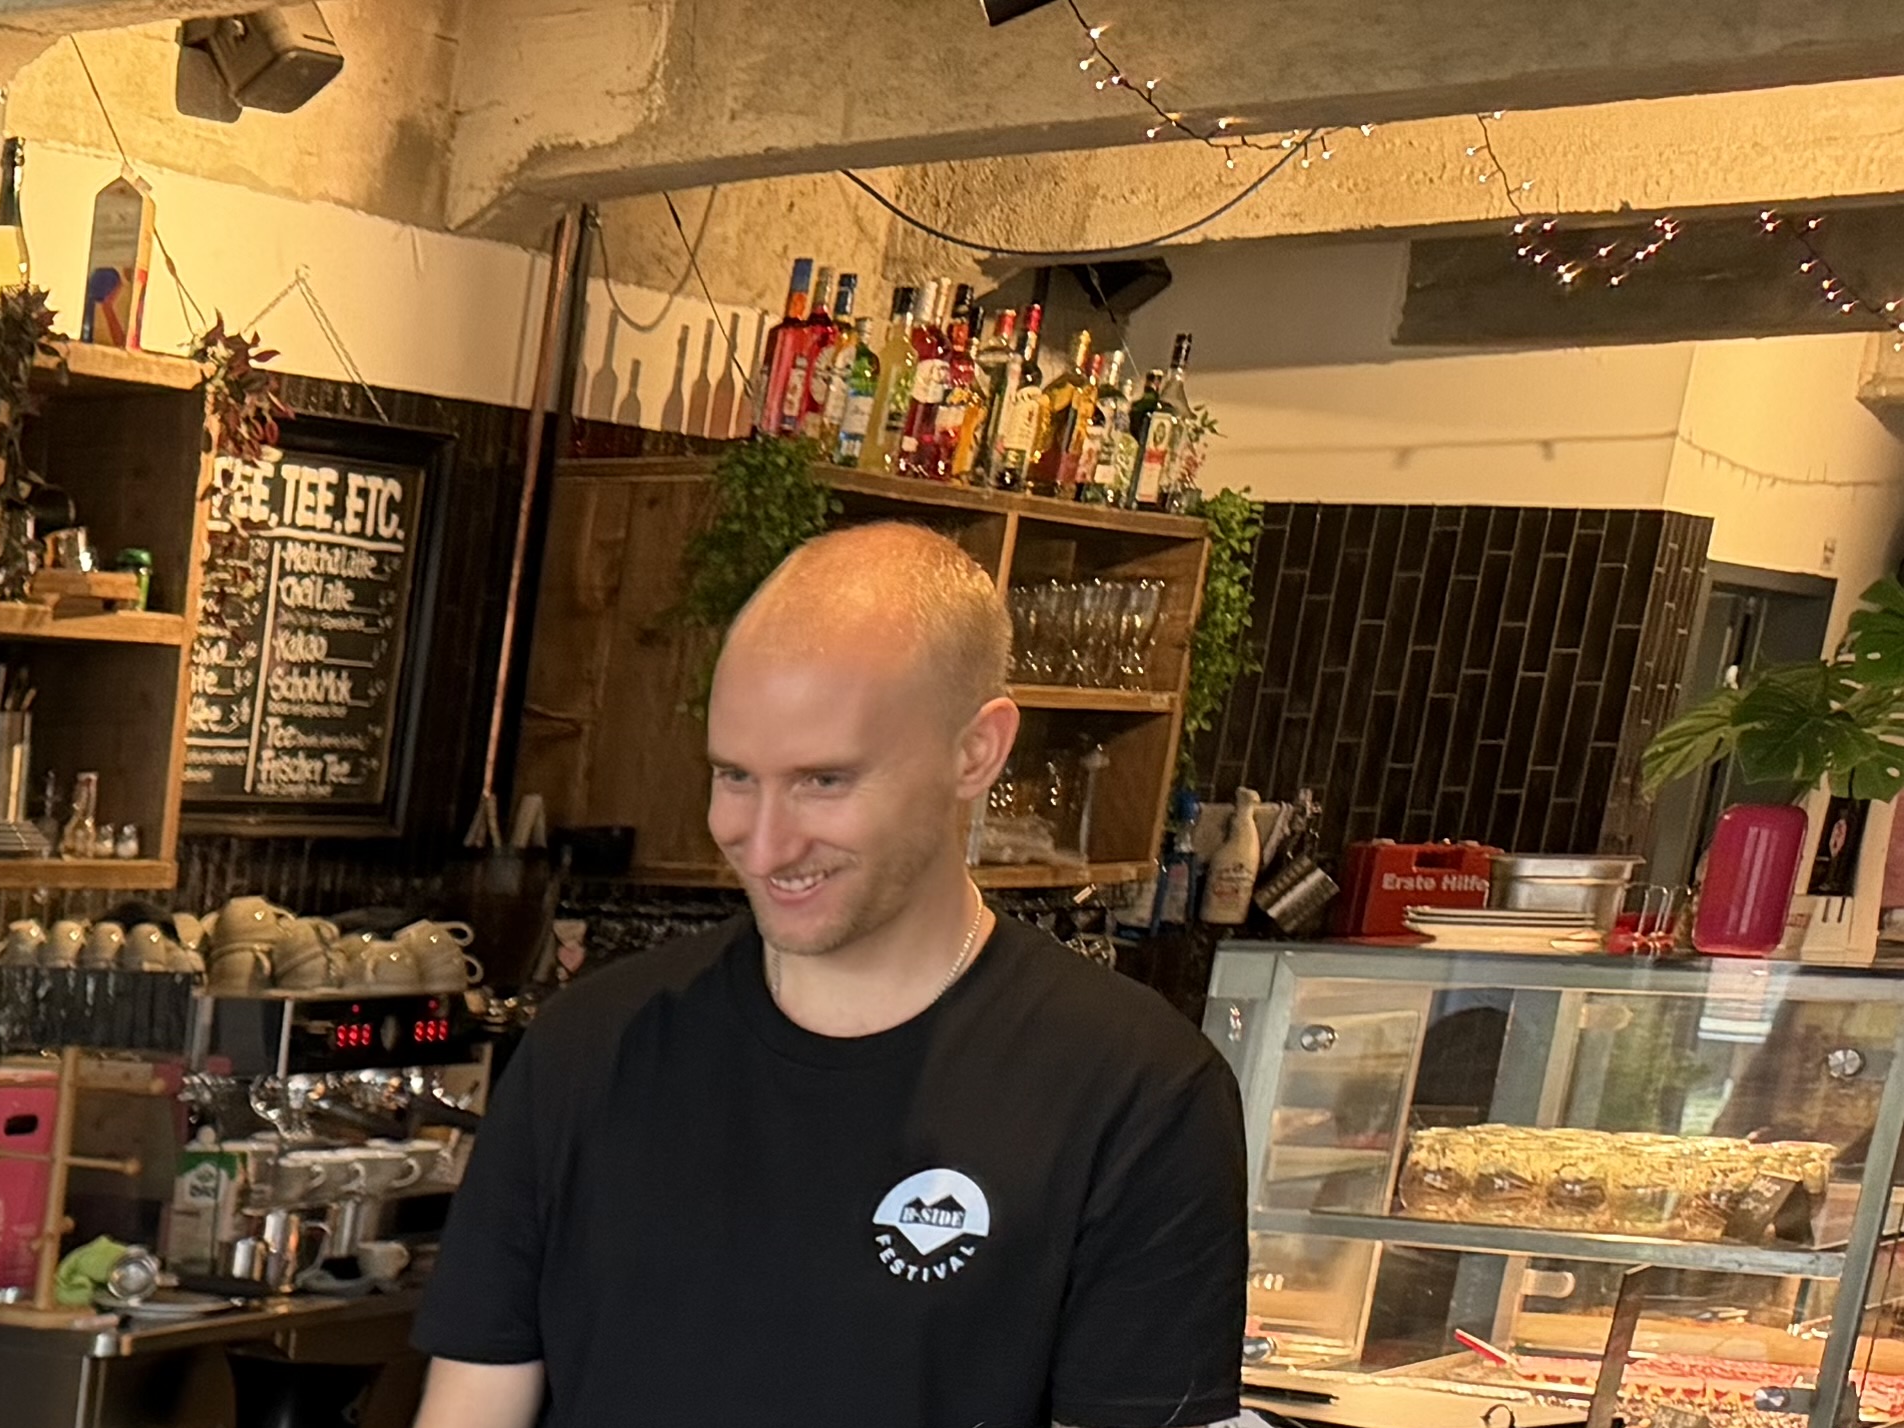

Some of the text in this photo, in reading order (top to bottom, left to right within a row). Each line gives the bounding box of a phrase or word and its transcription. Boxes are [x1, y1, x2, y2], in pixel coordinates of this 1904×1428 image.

[345, 473, 405, 539] ETC.
[1381, 871, 1490, 893] Erste Hilfe
[876, 1233, 976, 1283] FESTIVAL
